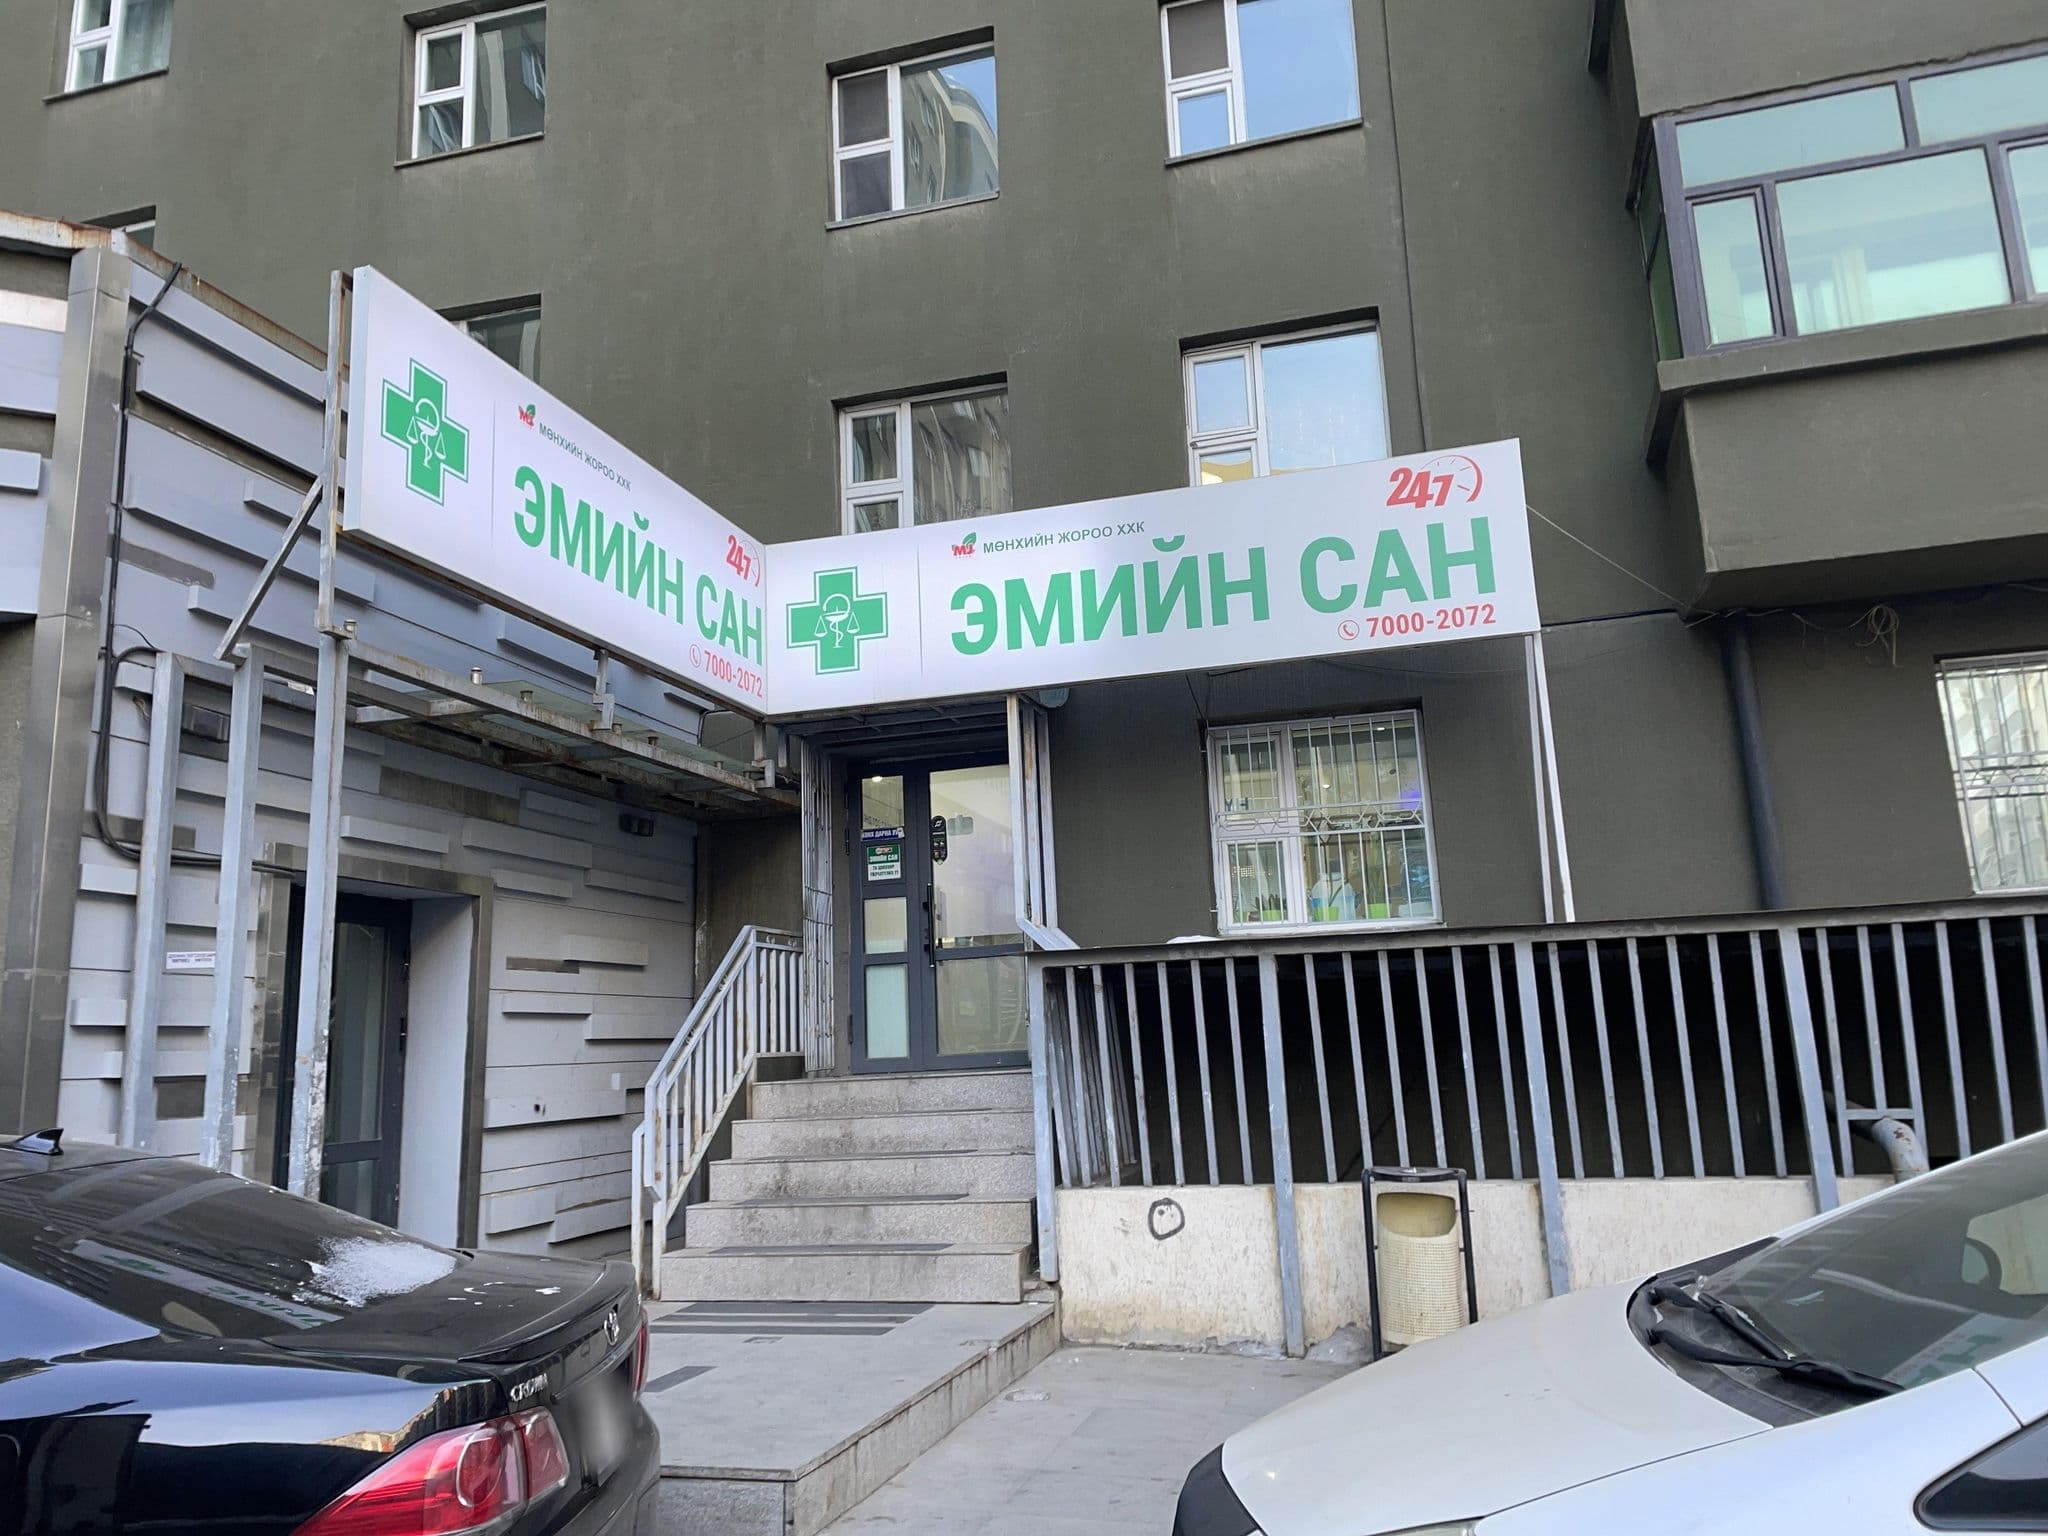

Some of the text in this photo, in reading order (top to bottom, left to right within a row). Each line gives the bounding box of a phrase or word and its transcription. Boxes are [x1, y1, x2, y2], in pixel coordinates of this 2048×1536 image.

[539, 422, 632, 491] МӨНХИЙН ЖОРОО ХХК
[1386, 467, 1455, 509] 247
[726, 534, 752, 581] 247
[983, 521, 1145, 554] МӨНХИЙН ЖОРОО ХХК
[514, 465, 763, 666] ЭМИЙН САН
[950, 516, 1498, 656] ЭМИЙН САН
[1366, 603, 1496, 638] 7000-2072
[704, 650, 763, 698] 7000-2072
